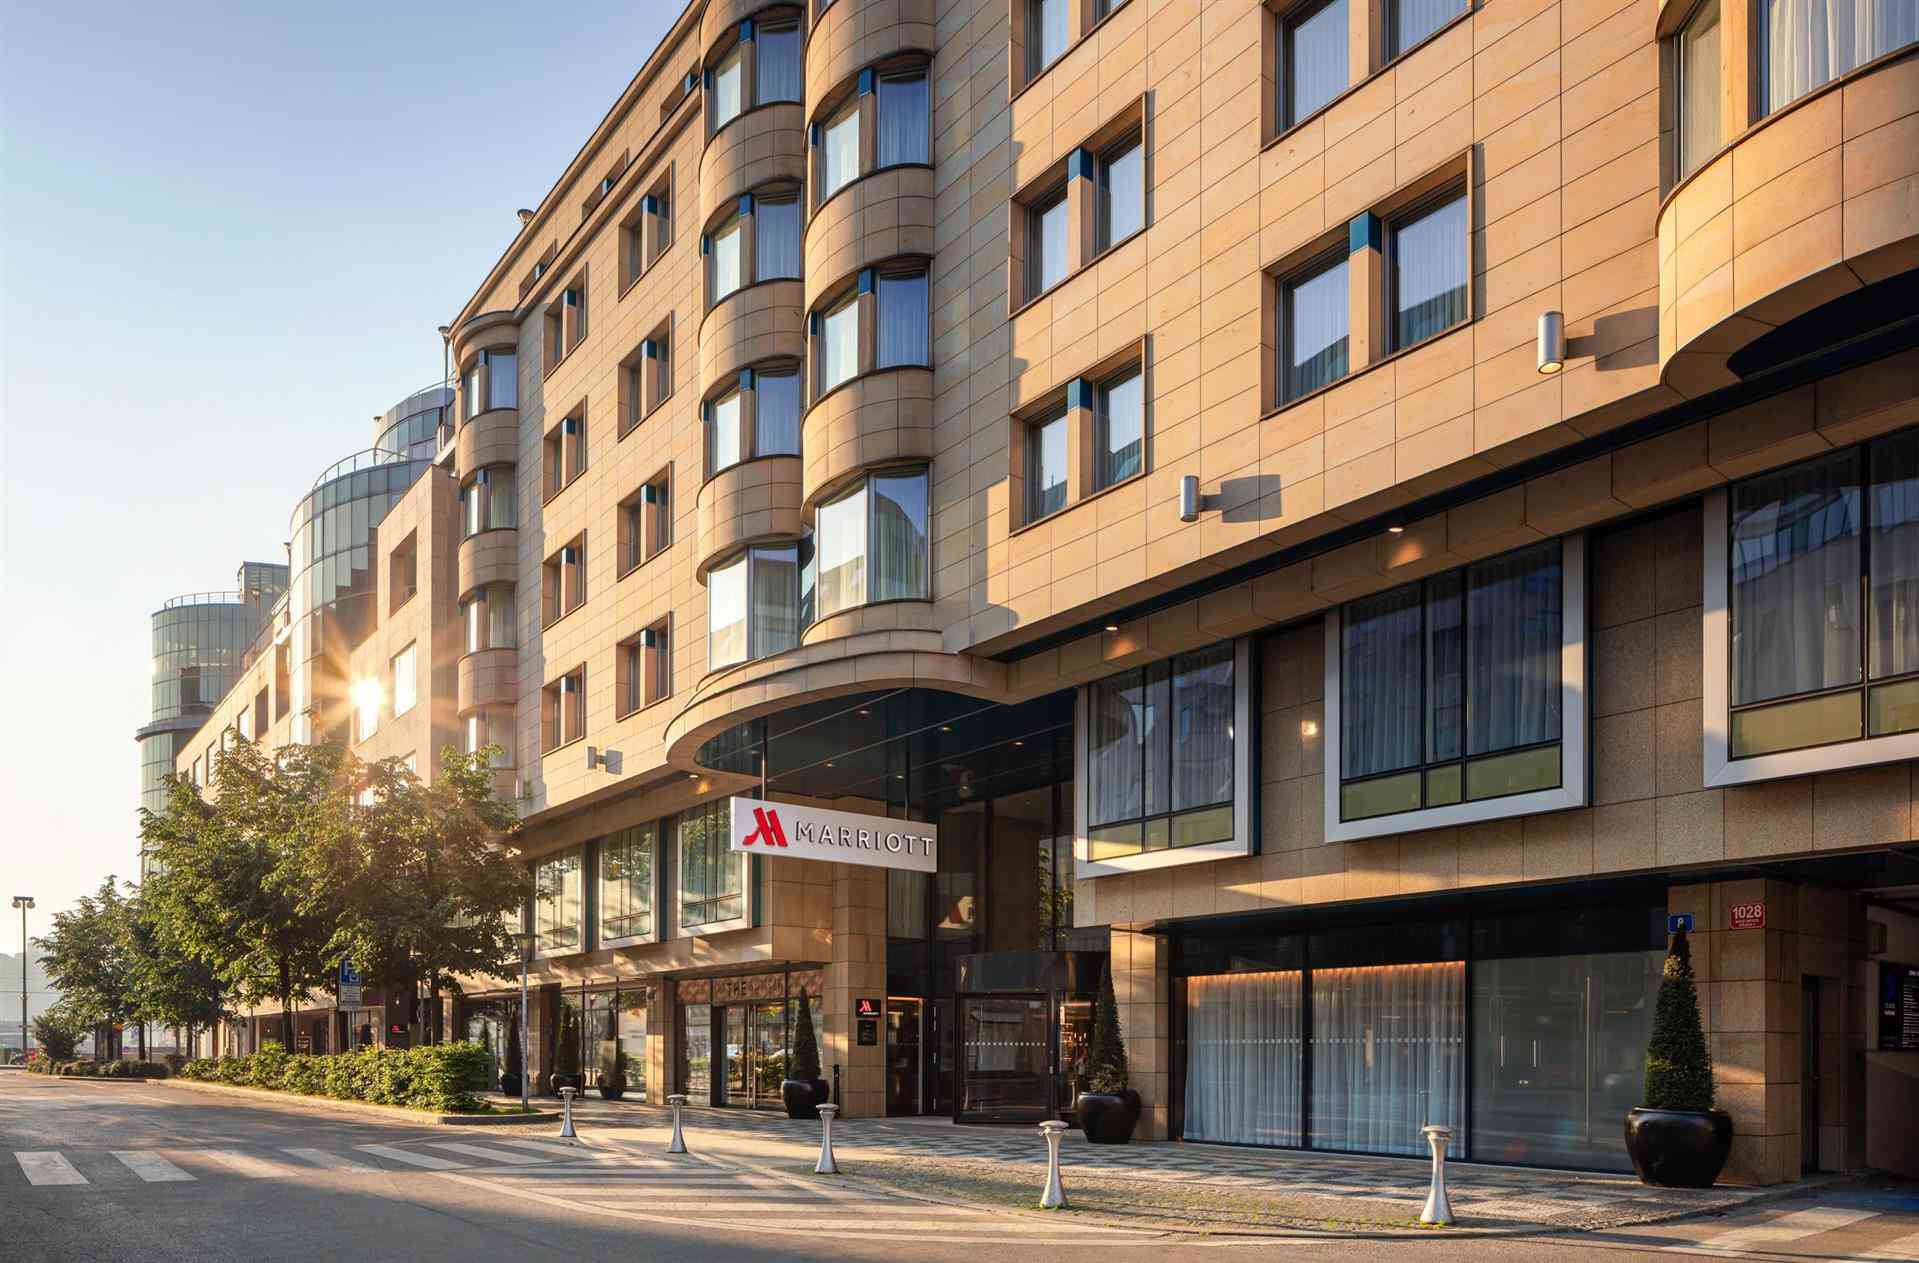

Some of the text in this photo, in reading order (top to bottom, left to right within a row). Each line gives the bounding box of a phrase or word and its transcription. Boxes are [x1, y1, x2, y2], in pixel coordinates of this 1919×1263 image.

[794, 820, 934, 856] MARRIOTT
[1732, 905, 1762, 919] 1028
[726, 982, 747, 997] THE
